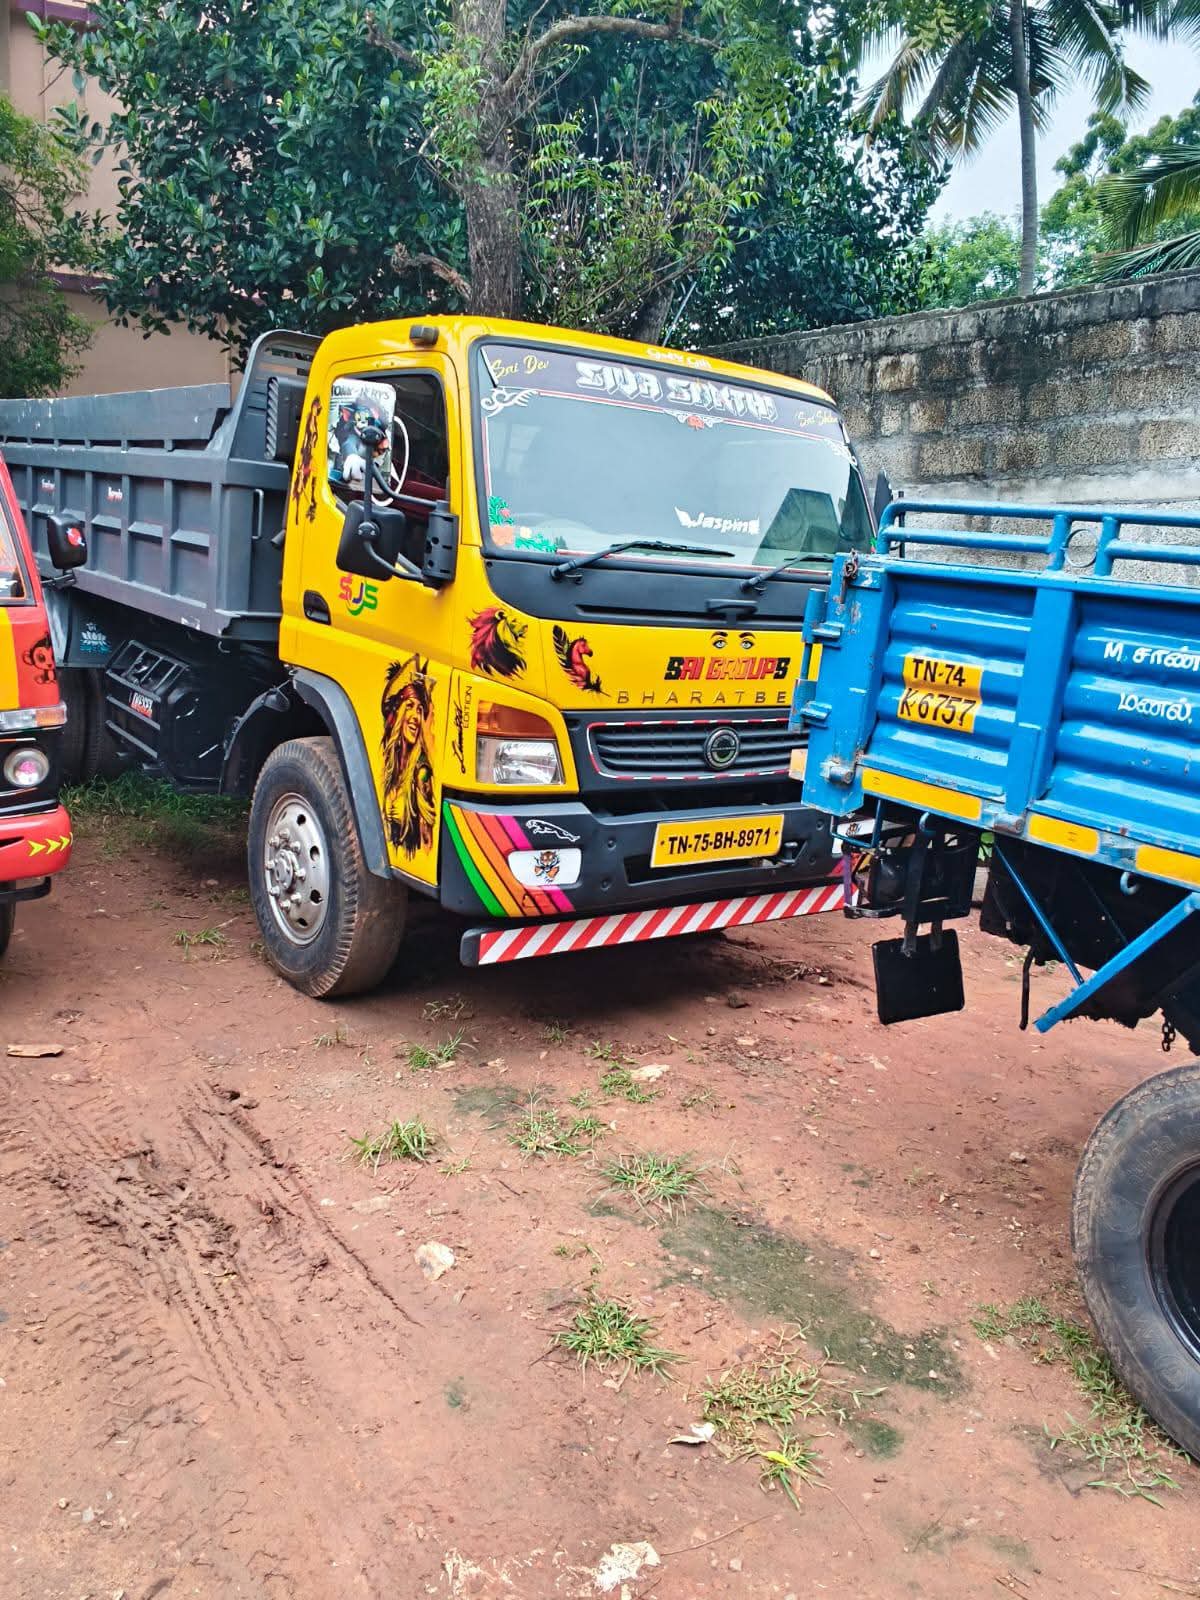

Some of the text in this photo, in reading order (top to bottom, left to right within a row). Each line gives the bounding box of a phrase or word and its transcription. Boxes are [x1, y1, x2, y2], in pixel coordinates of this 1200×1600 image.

[576, 361, 663, 403] SIVA
[664, 656, 790, 680] SAI GROUPS
[913, 658, 966, 687] TN-74
[463, 686, 472, 728] EDITION
[668, 828, 771, 854] TN-75-BH-8971
